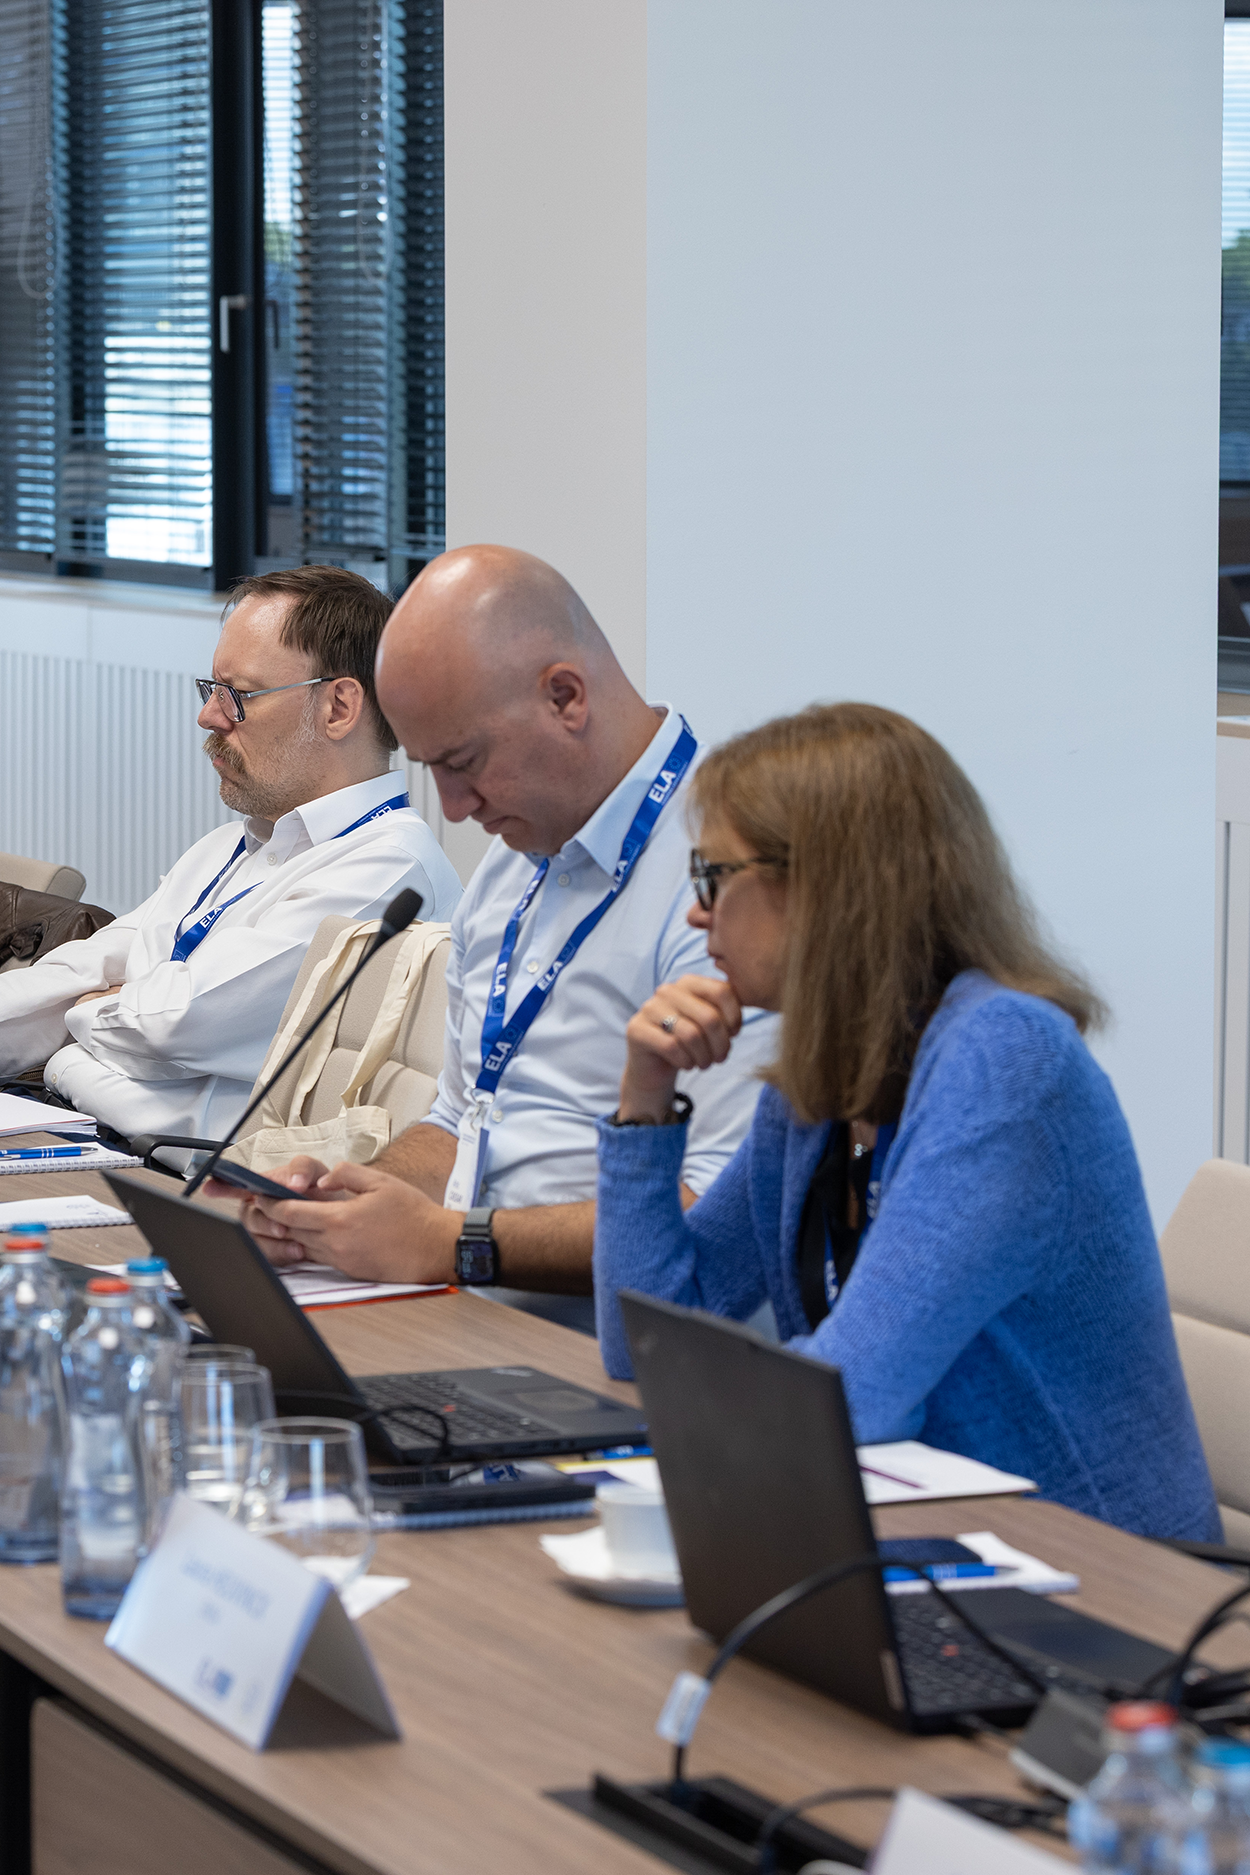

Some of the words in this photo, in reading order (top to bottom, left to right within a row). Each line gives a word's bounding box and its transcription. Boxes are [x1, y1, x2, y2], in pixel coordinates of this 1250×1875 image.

[647, 769, 677, 804] ELA
[199, 907, 223, 929] ELA
[492, 962, 508, 998] ELA
[537, 960, 564, 991] ELA
[485, 1041, 513, 1072] ELA
